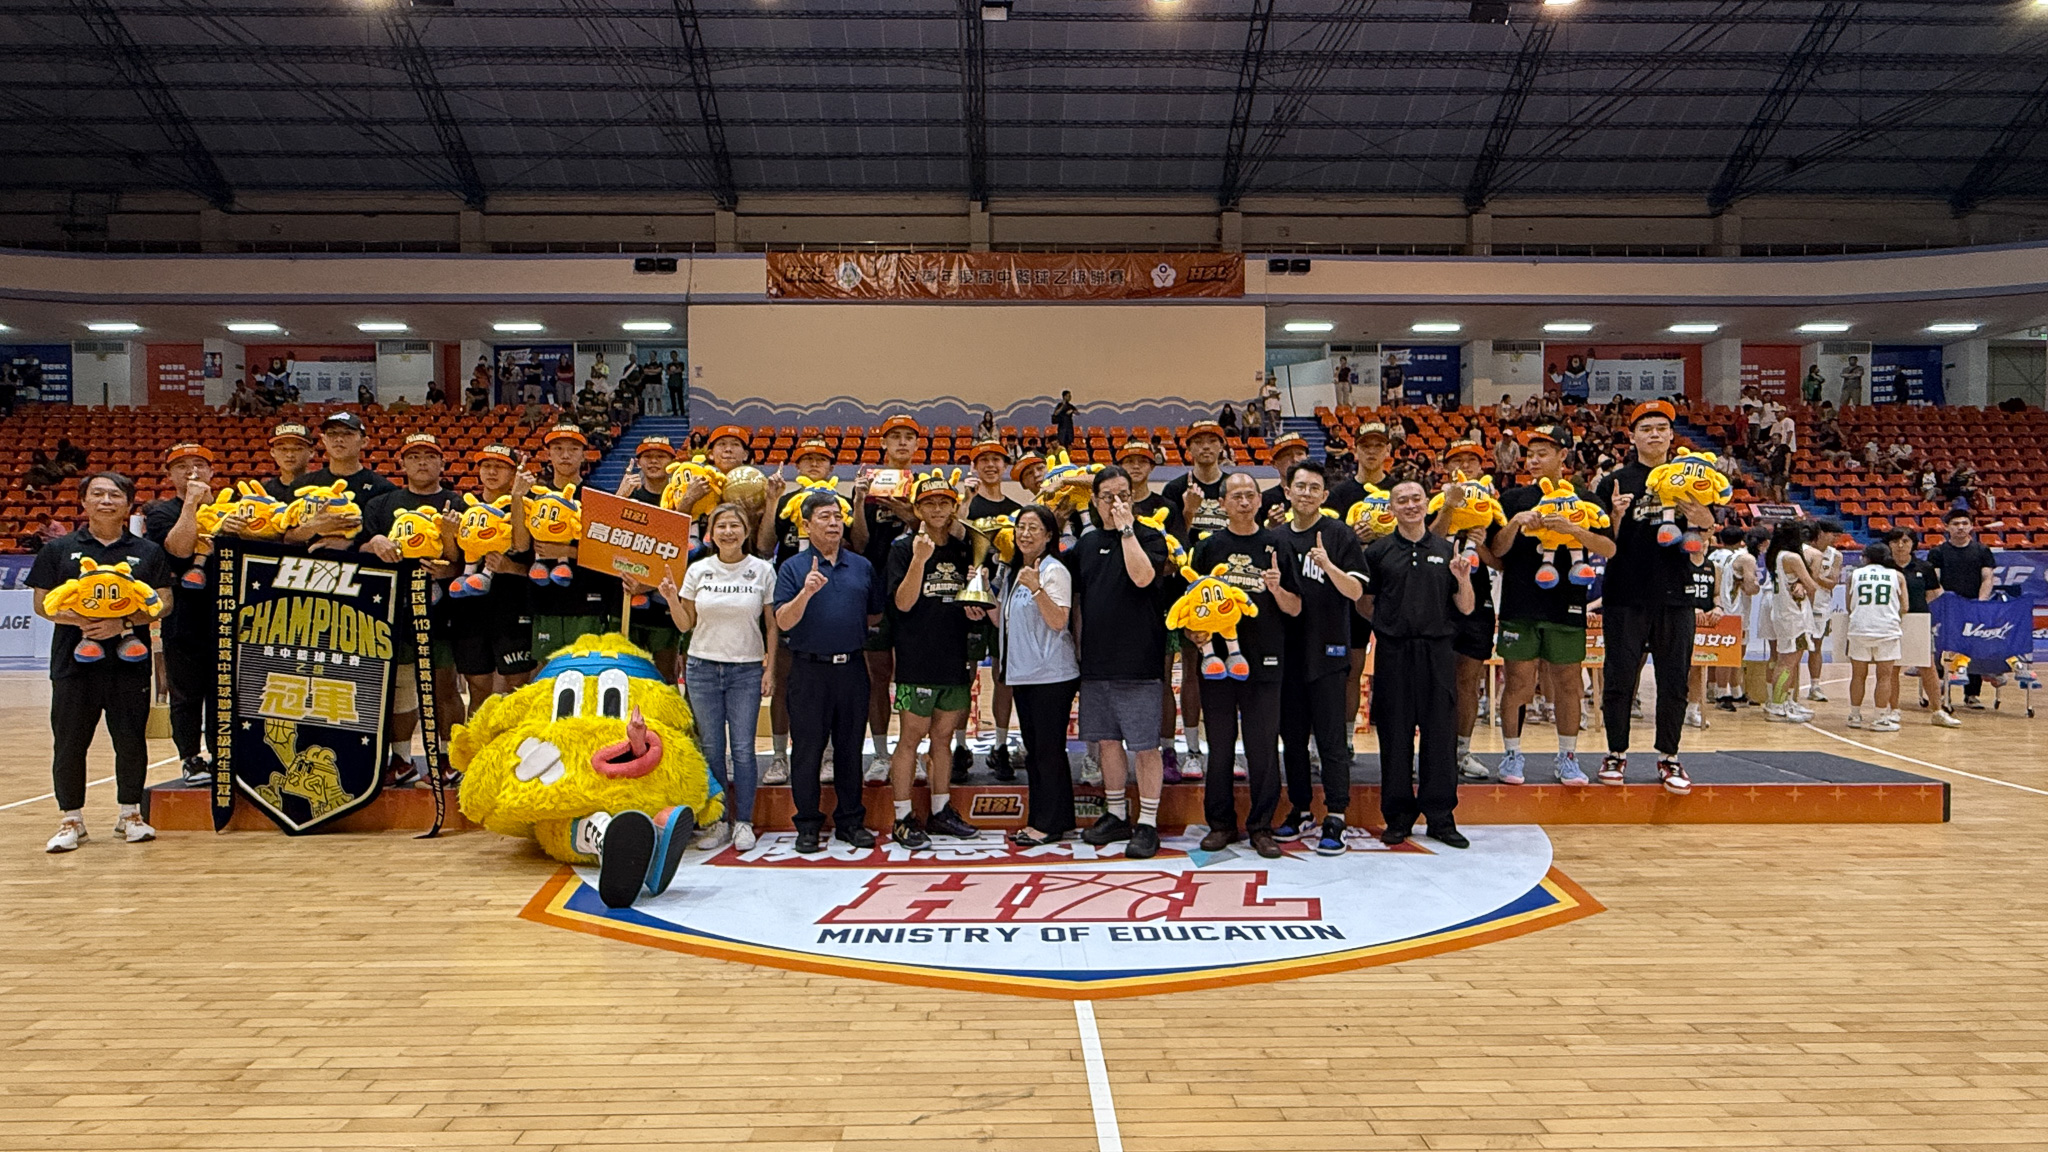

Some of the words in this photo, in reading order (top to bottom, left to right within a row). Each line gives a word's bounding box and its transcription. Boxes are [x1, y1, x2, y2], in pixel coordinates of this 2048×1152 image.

[622, 508, 648, 524] HBL
[587, 521, 680, 560] 高師附中
[271, 555, 362, 597] HBL
[1857, 584, 1892, 605] 58
[237, 596, 393, 660] CHAMPIONS
[503, 650, 531, 665] NIKE
[258, 672, 360, 725] 冠軍
[974, 796, 1020, 814] HBL
[813, 870, 1322, 924] HBL
[816, 927, 1021, 943] MINISTRY
[1040, 926, 1090, 942] OF
[1108, 925, 1347, 942] EDUCATION
